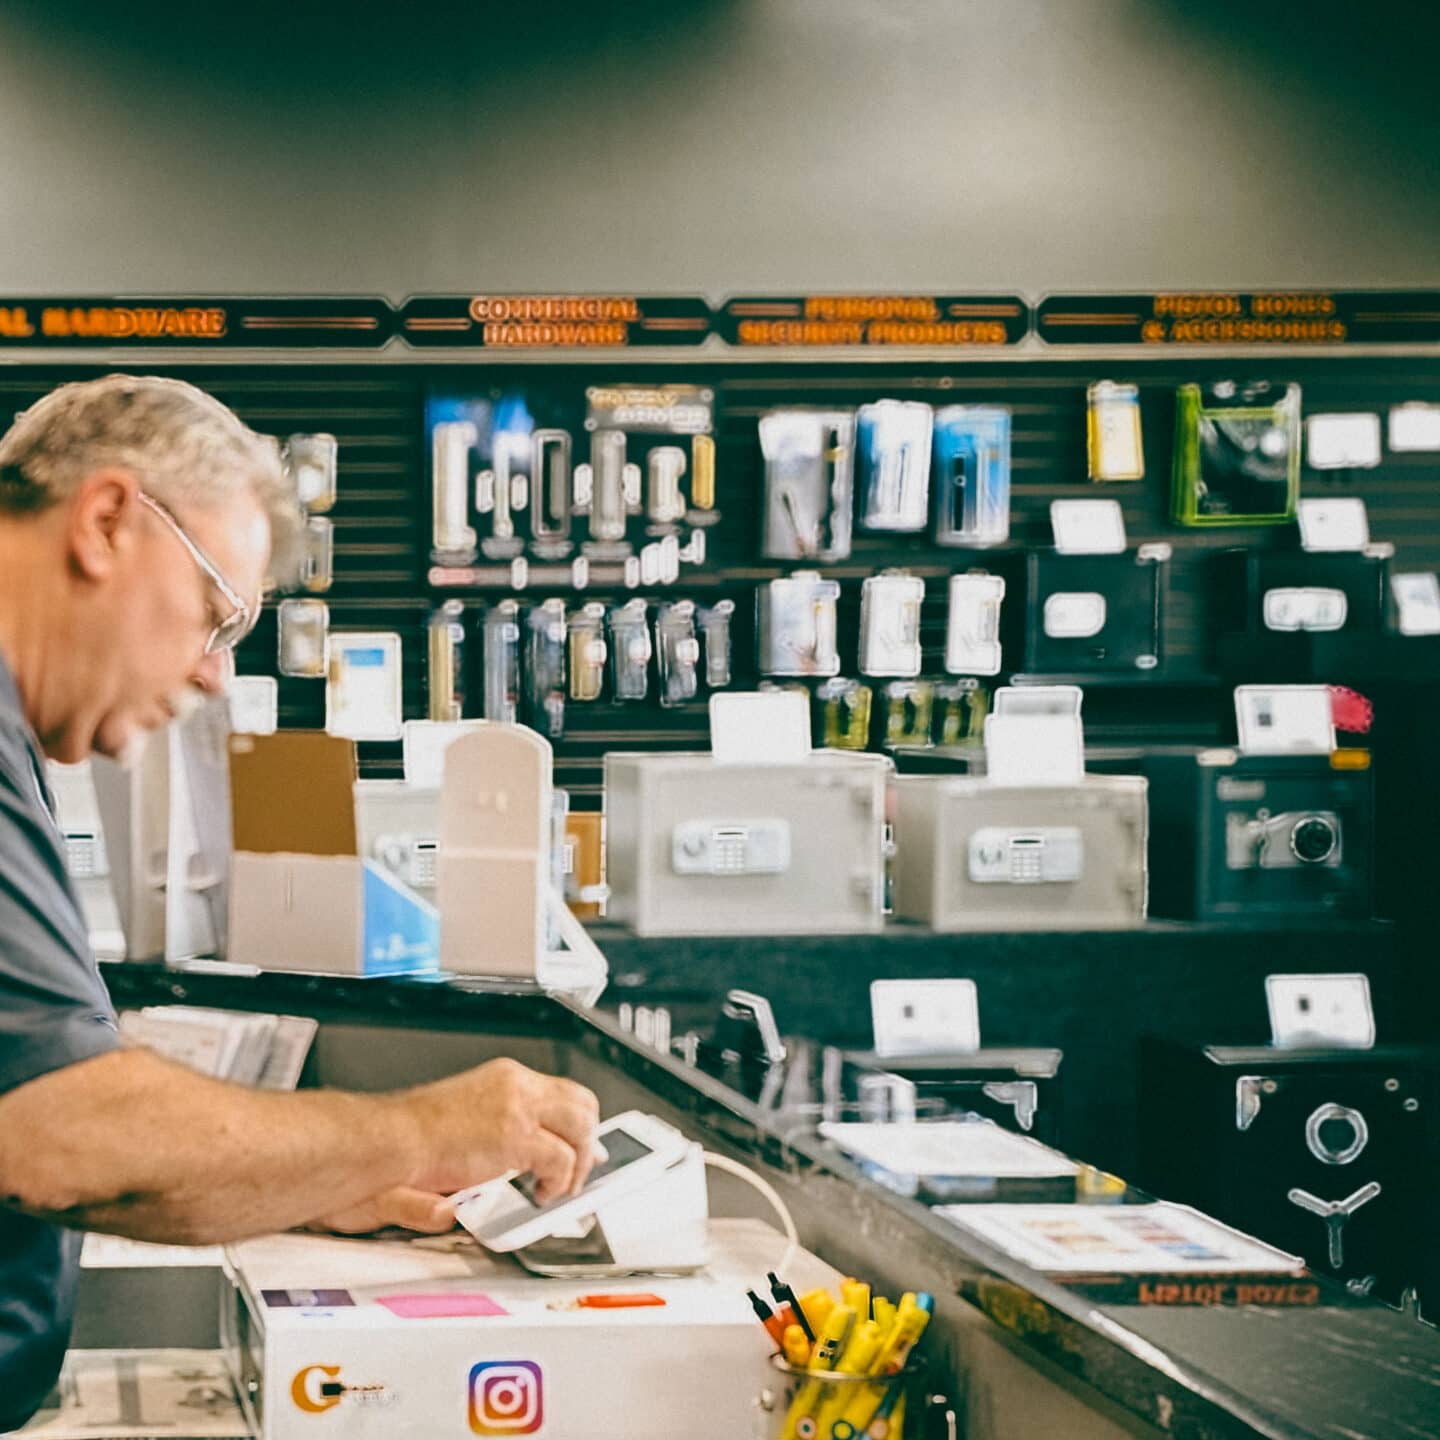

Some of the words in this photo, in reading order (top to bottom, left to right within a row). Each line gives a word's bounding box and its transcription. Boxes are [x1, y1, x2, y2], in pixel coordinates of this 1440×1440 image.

[469, 296, 641, 321] COMMERCIAL
[42, 307, 227, 336] HARDWARE
[483, 322, 628, 346] HARDWARE
